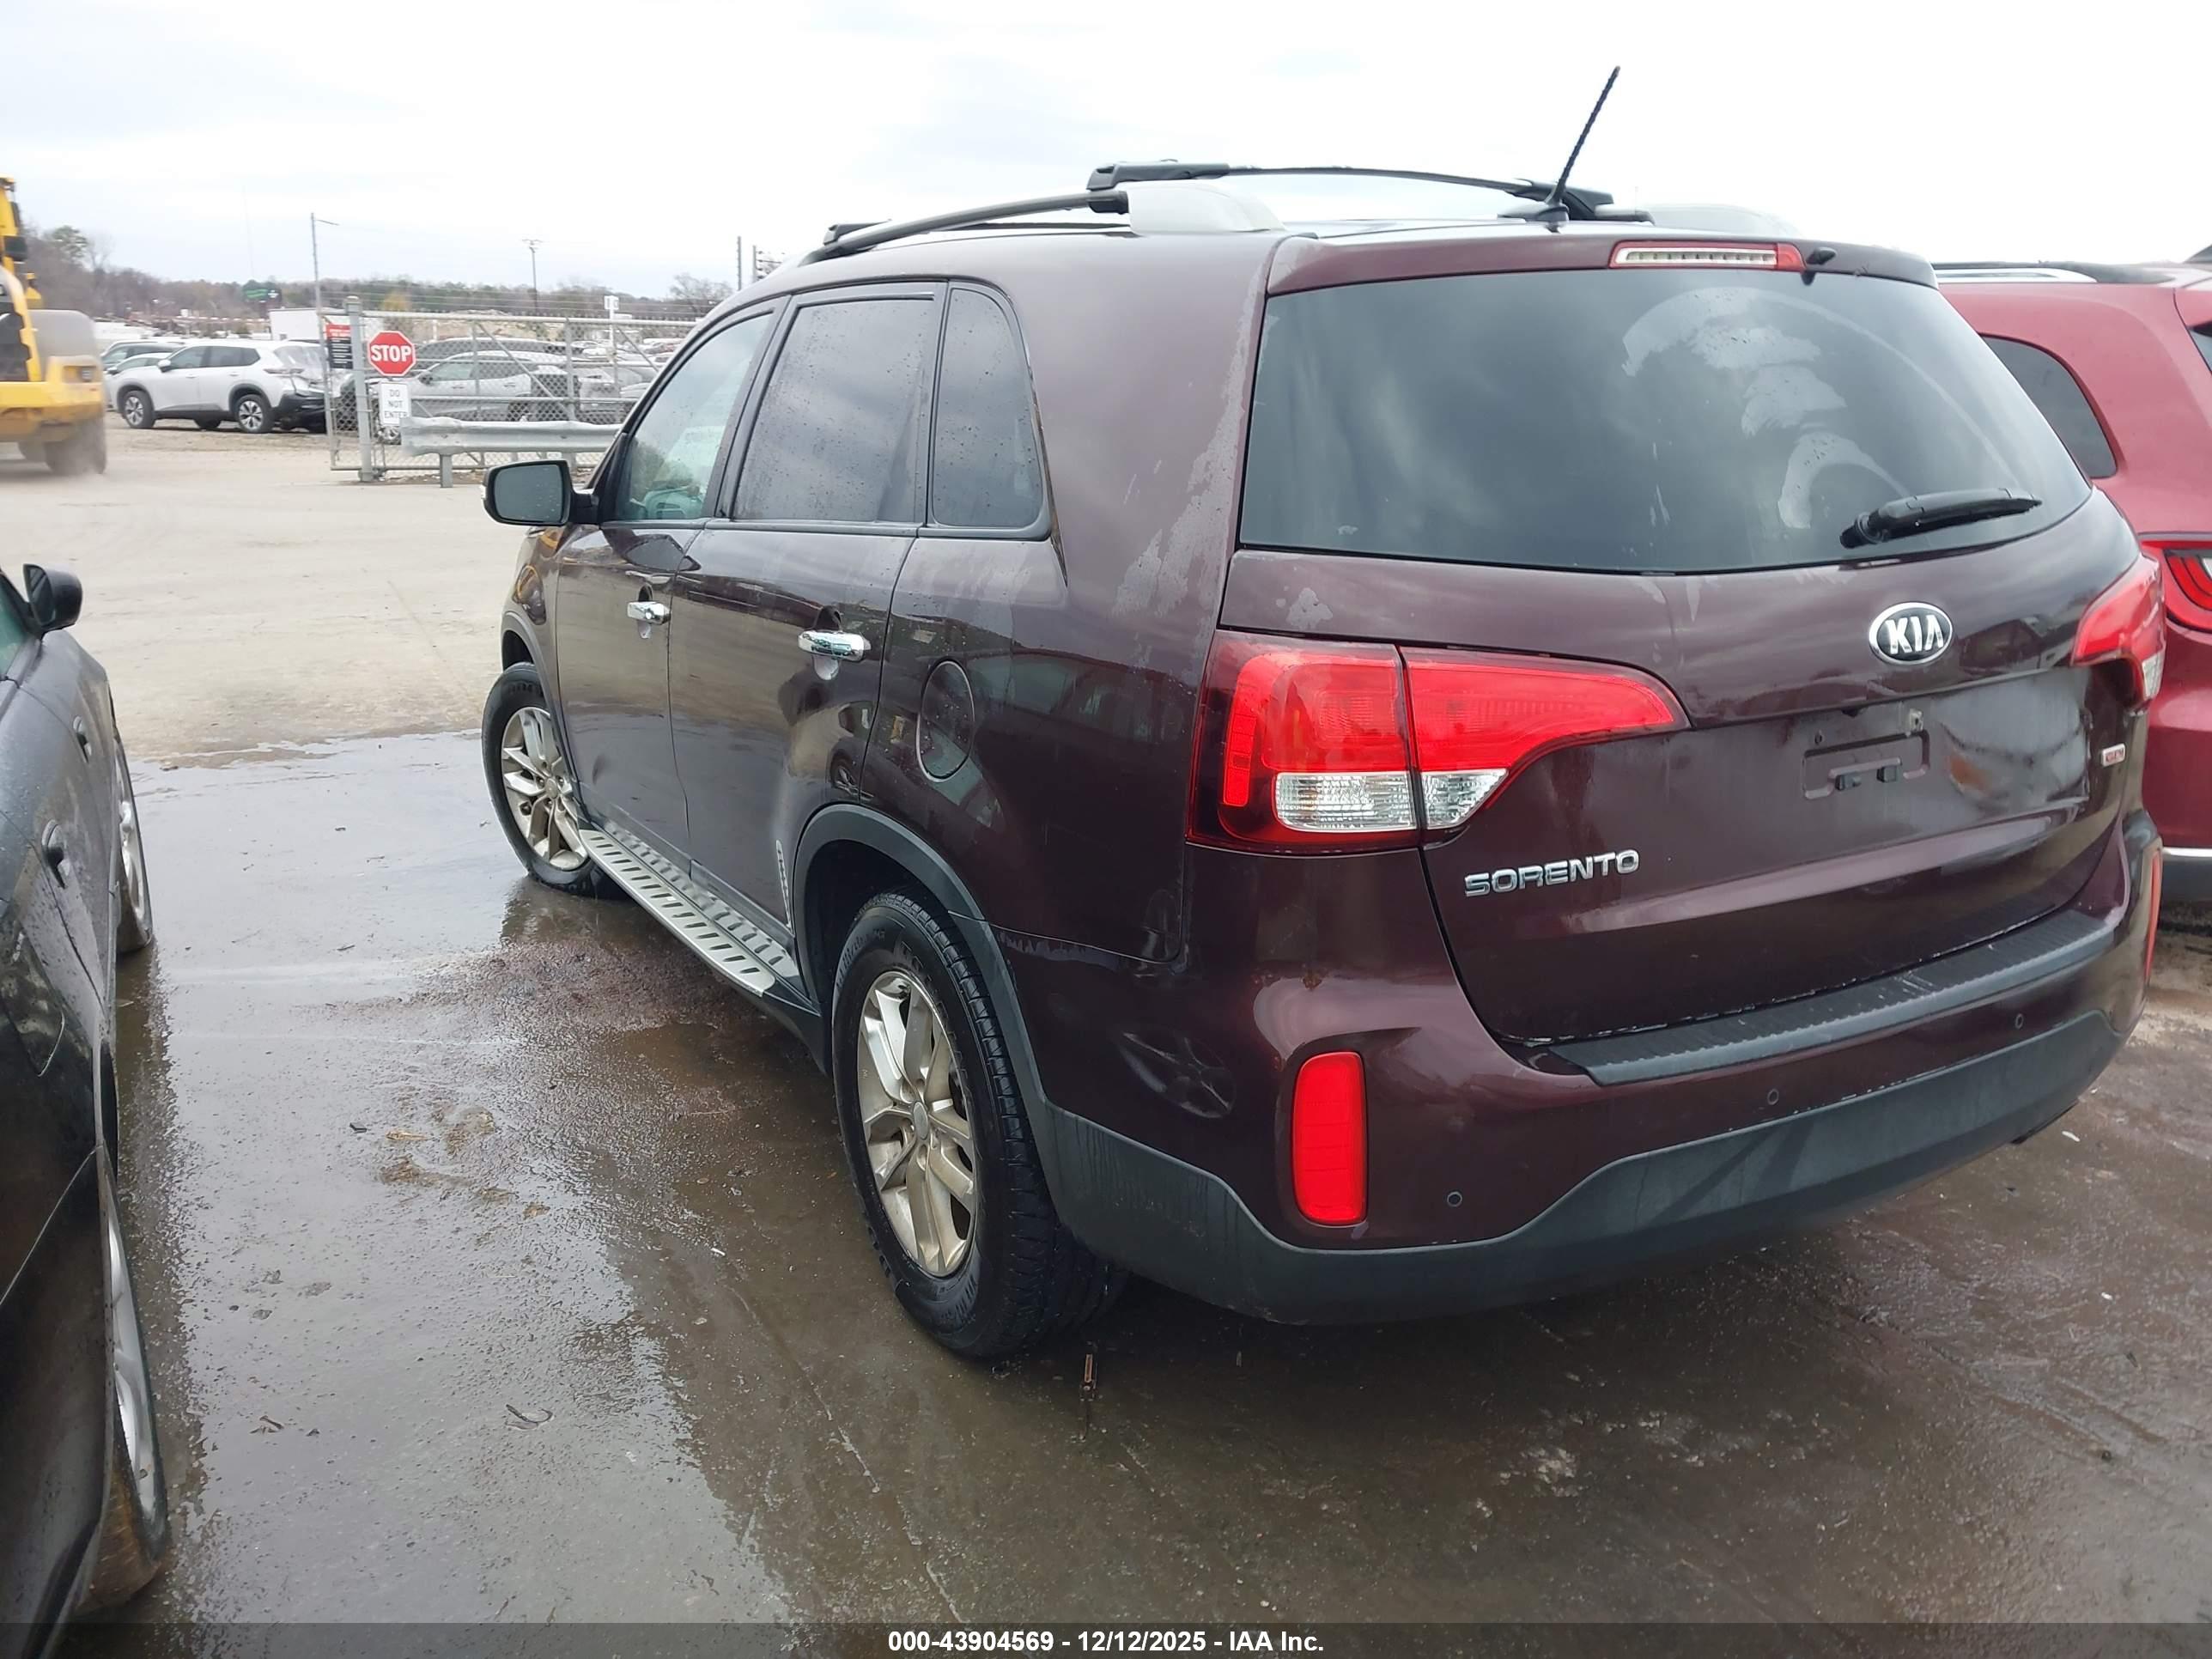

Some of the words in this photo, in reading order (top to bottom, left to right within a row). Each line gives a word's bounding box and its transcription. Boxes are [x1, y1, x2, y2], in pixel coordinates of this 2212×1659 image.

[371, 344, 412, 362] STOP
[1885, 615, 1944, 655] KIA
[1464, 849, 1640, 897] SORENTO
